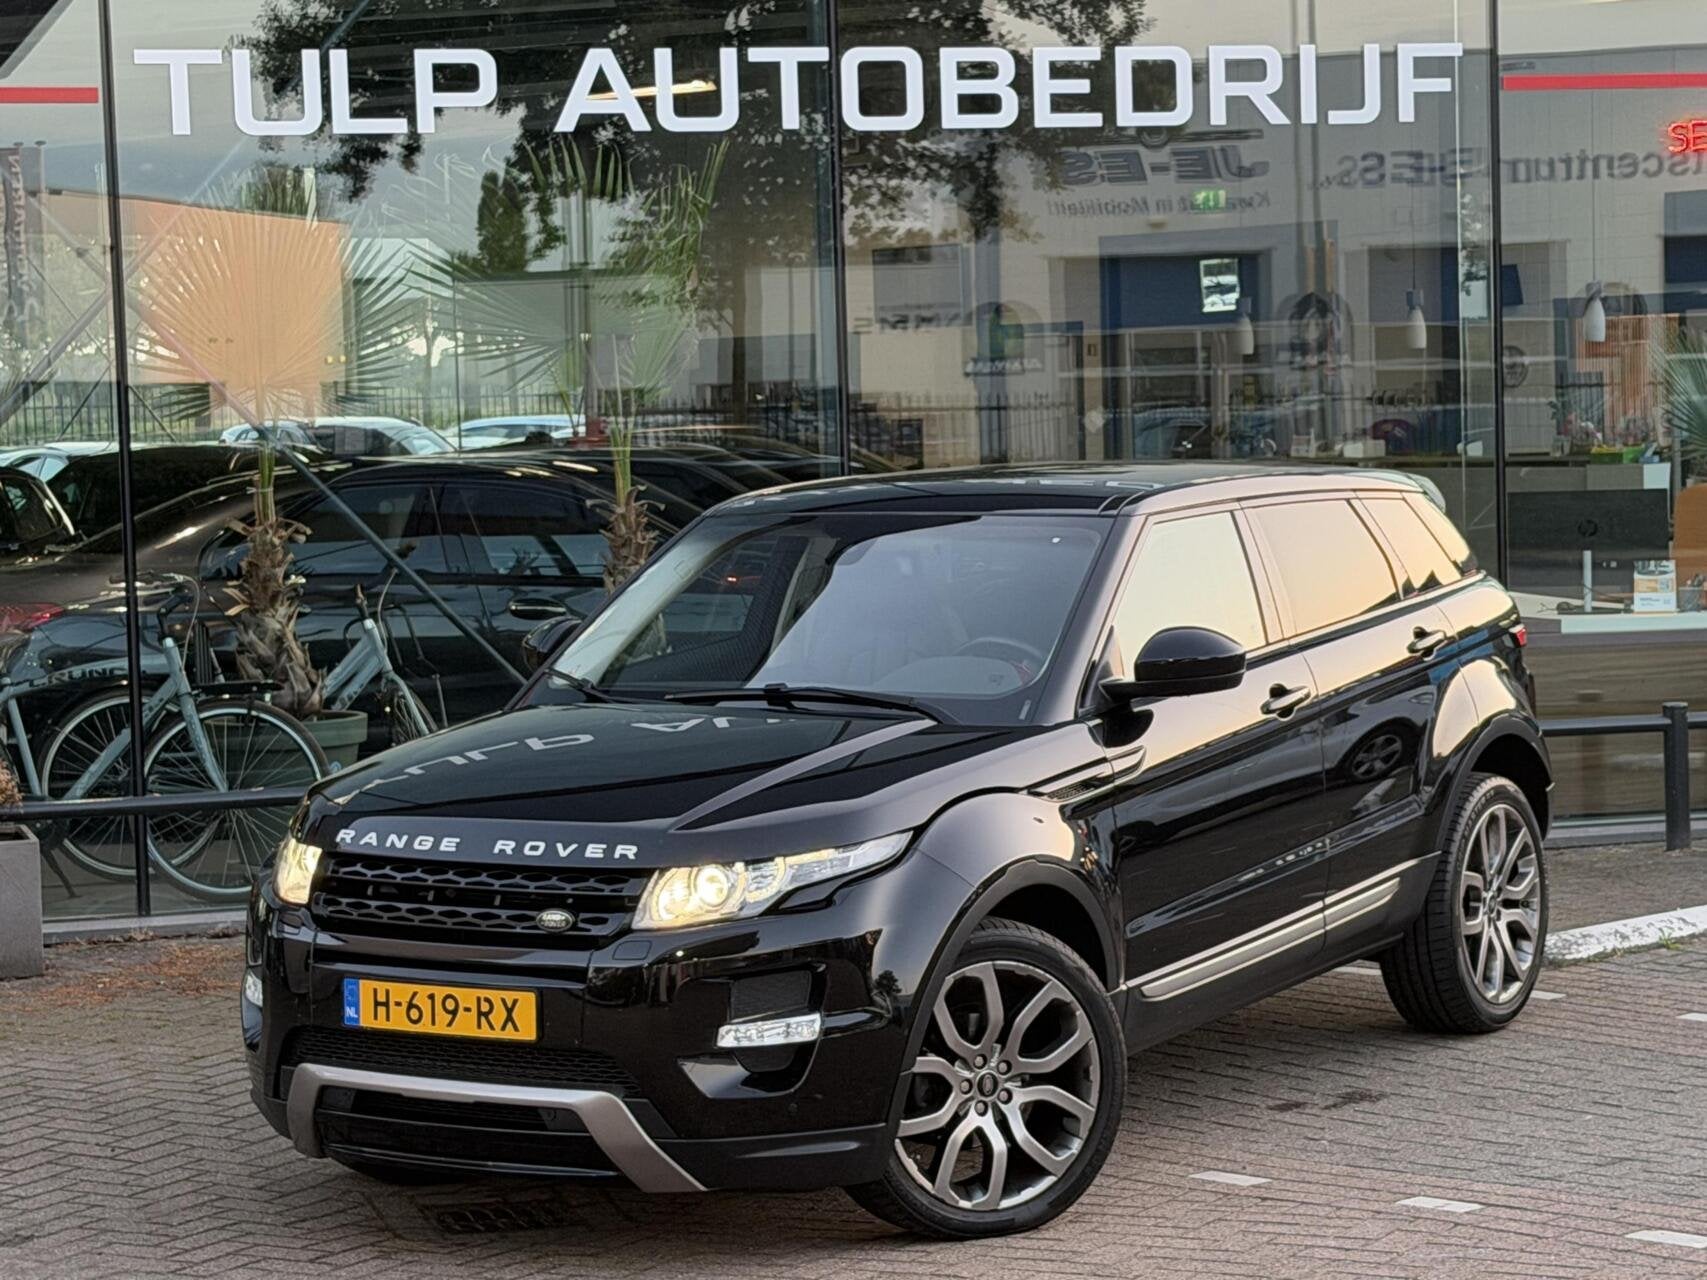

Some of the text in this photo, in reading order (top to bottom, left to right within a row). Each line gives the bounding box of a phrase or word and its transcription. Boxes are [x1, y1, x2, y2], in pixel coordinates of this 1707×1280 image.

[133, 42, 1463, 136] TULP AUTOBEDRIJF
[336, 829, 639, 860] RANGE ROVER
[344, 1007, 358, 1019] NL
[373, 988, 520, 1032] H-619-RX
